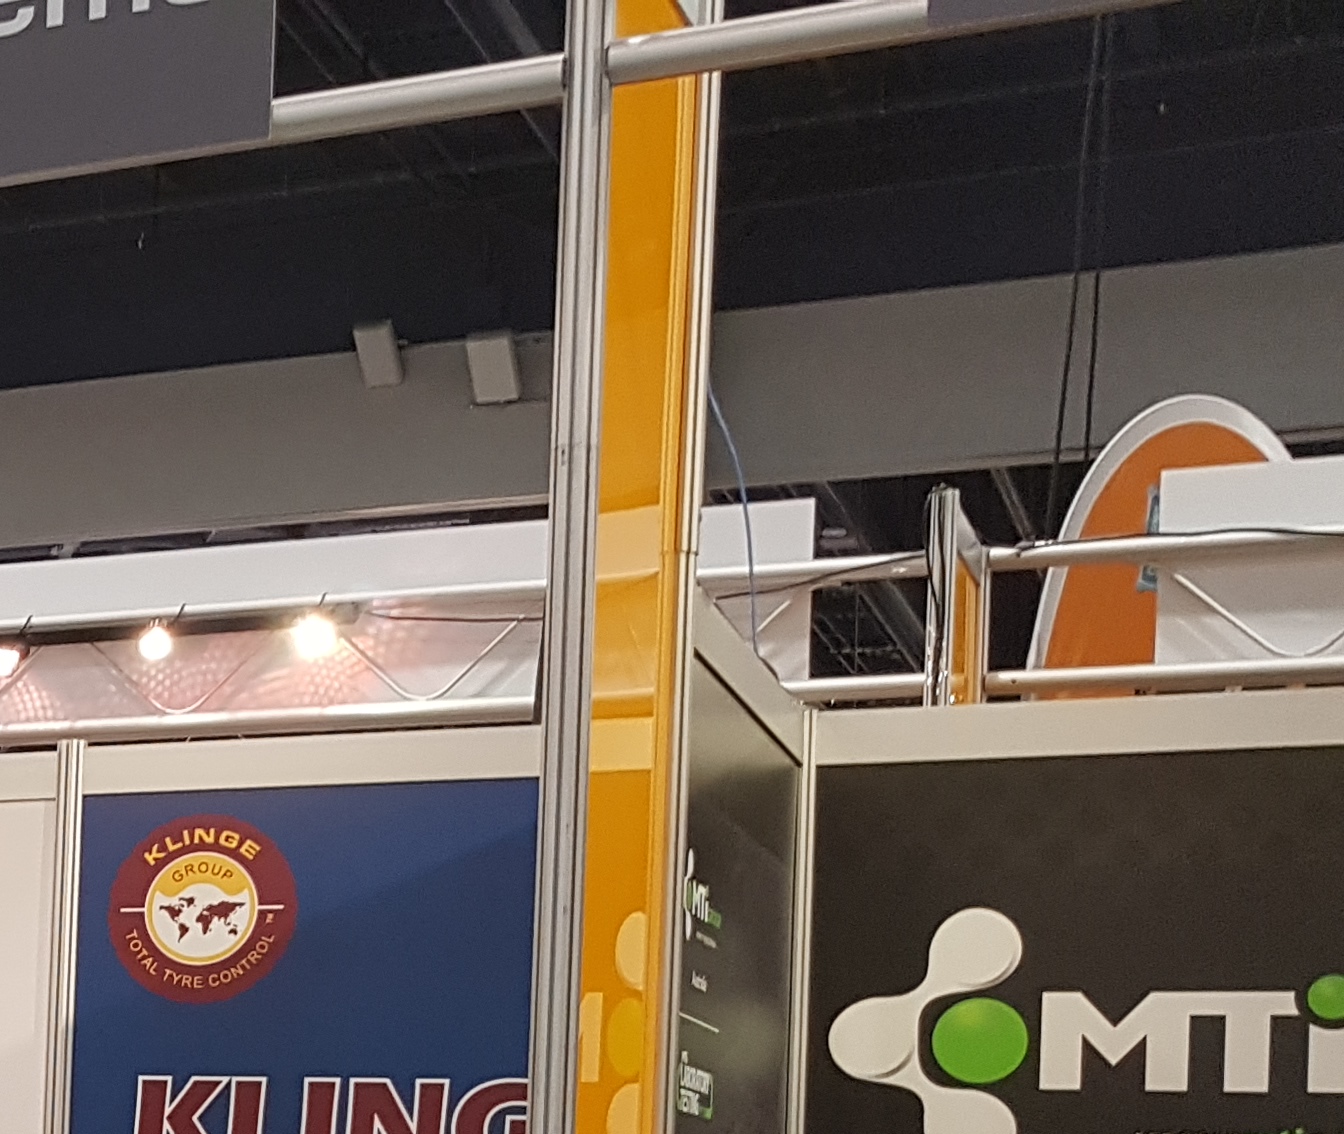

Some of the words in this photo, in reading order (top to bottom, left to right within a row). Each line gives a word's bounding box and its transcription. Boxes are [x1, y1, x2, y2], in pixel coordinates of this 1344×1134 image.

[143, 827, 262, 866] KLINGE
[171, 861, 235, 883] GROUP
[125, 928, 159, 976] TOTAL
[162, 968, 205, 988] TYRE
[208, 933, 276, 989] CONTROL
